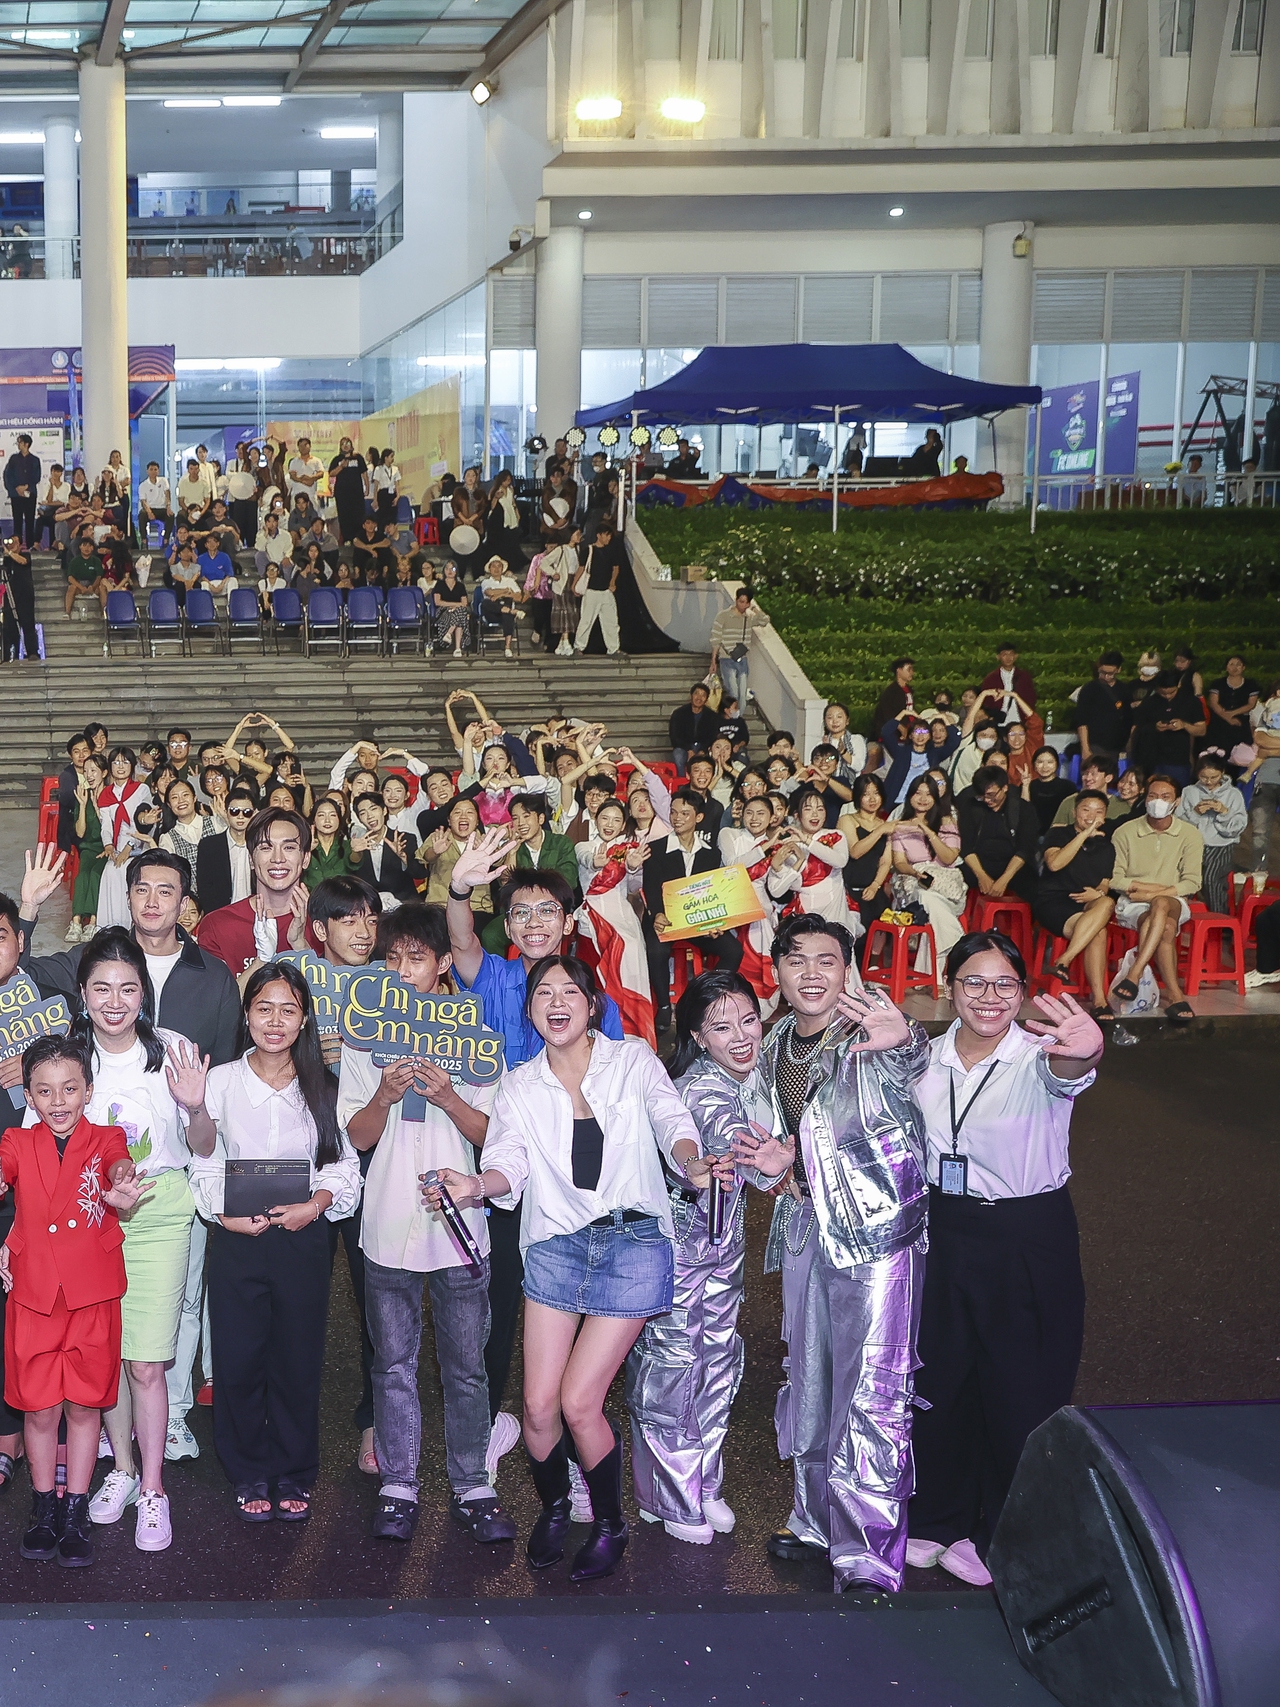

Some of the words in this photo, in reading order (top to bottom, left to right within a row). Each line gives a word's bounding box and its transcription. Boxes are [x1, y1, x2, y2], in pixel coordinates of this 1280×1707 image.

[686, 909, 708, 924] GIẢI
[349, 976, 409, 1017] Chị
[413, 998, 478, 1033] ngã
